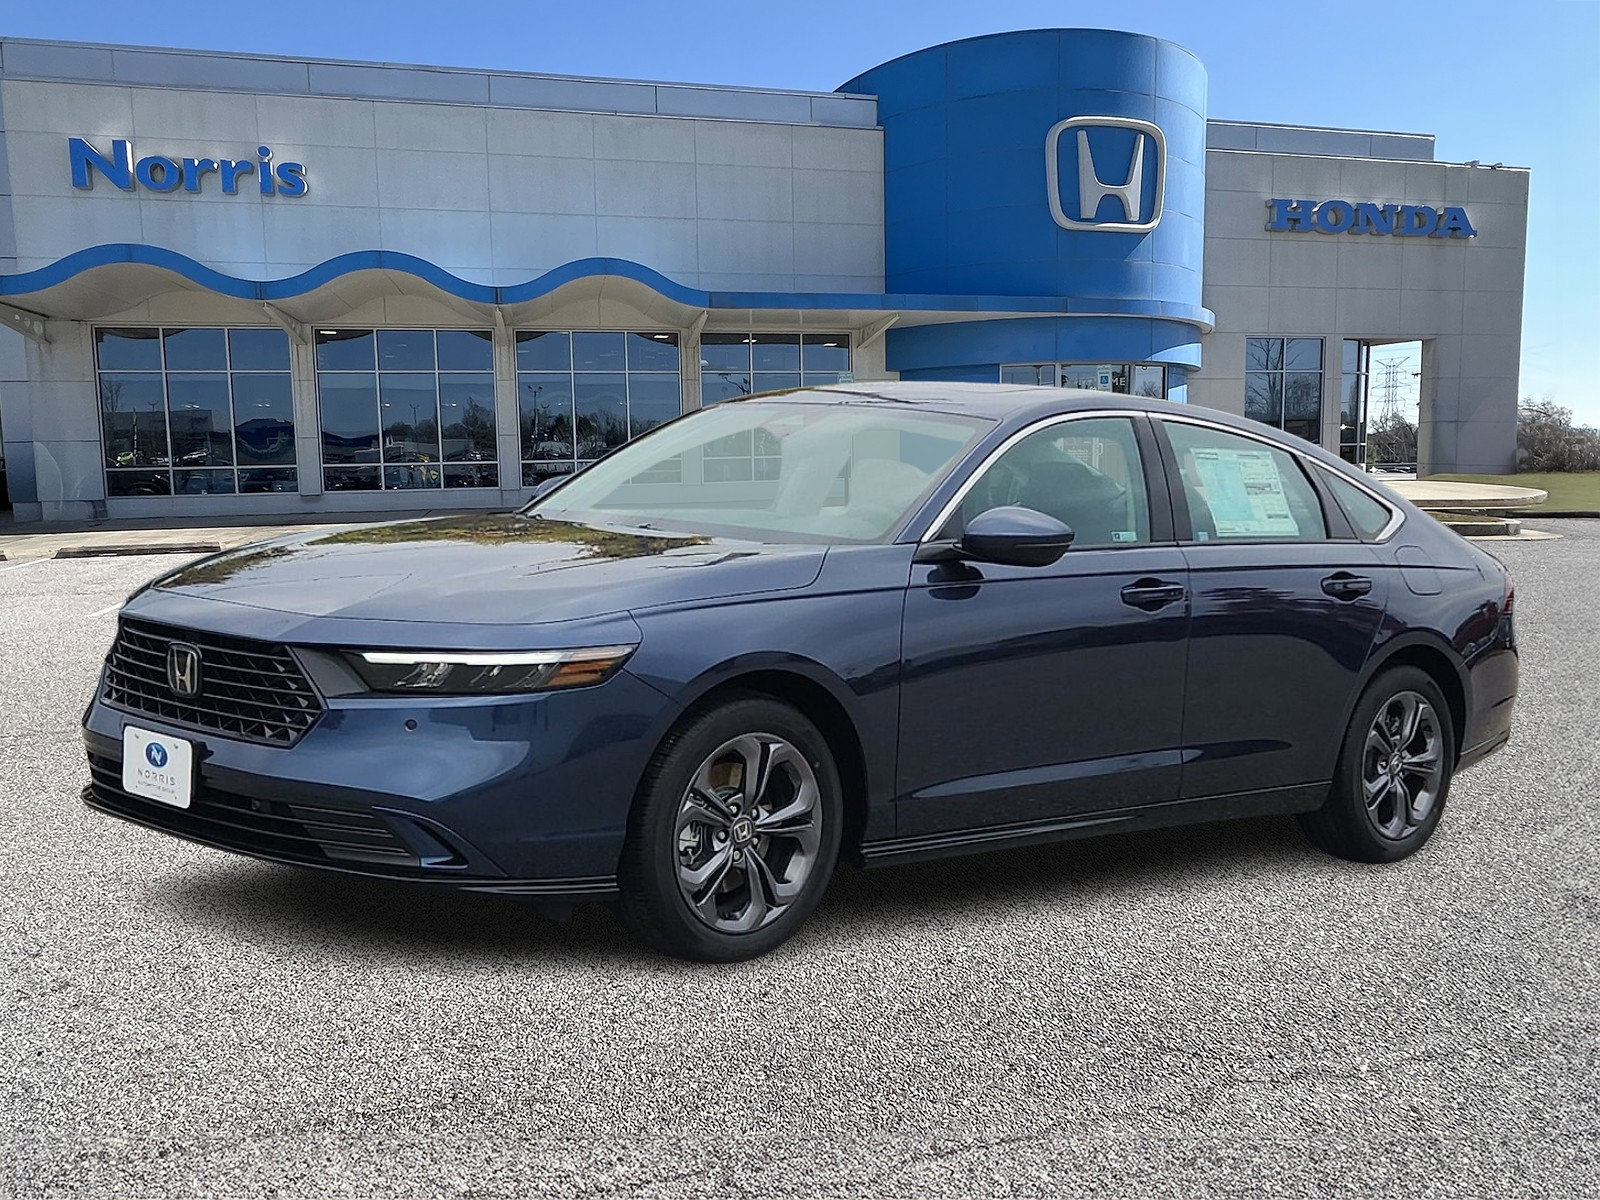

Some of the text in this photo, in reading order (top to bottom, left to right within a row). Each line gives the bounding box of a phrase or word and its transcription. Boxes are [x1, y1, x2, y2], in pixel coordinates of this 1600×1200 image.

[68, 137, 308, 197] Norris
[1266, 198, 1478, 239] HONDA
[138, 768, 175, 785] NORRIS
